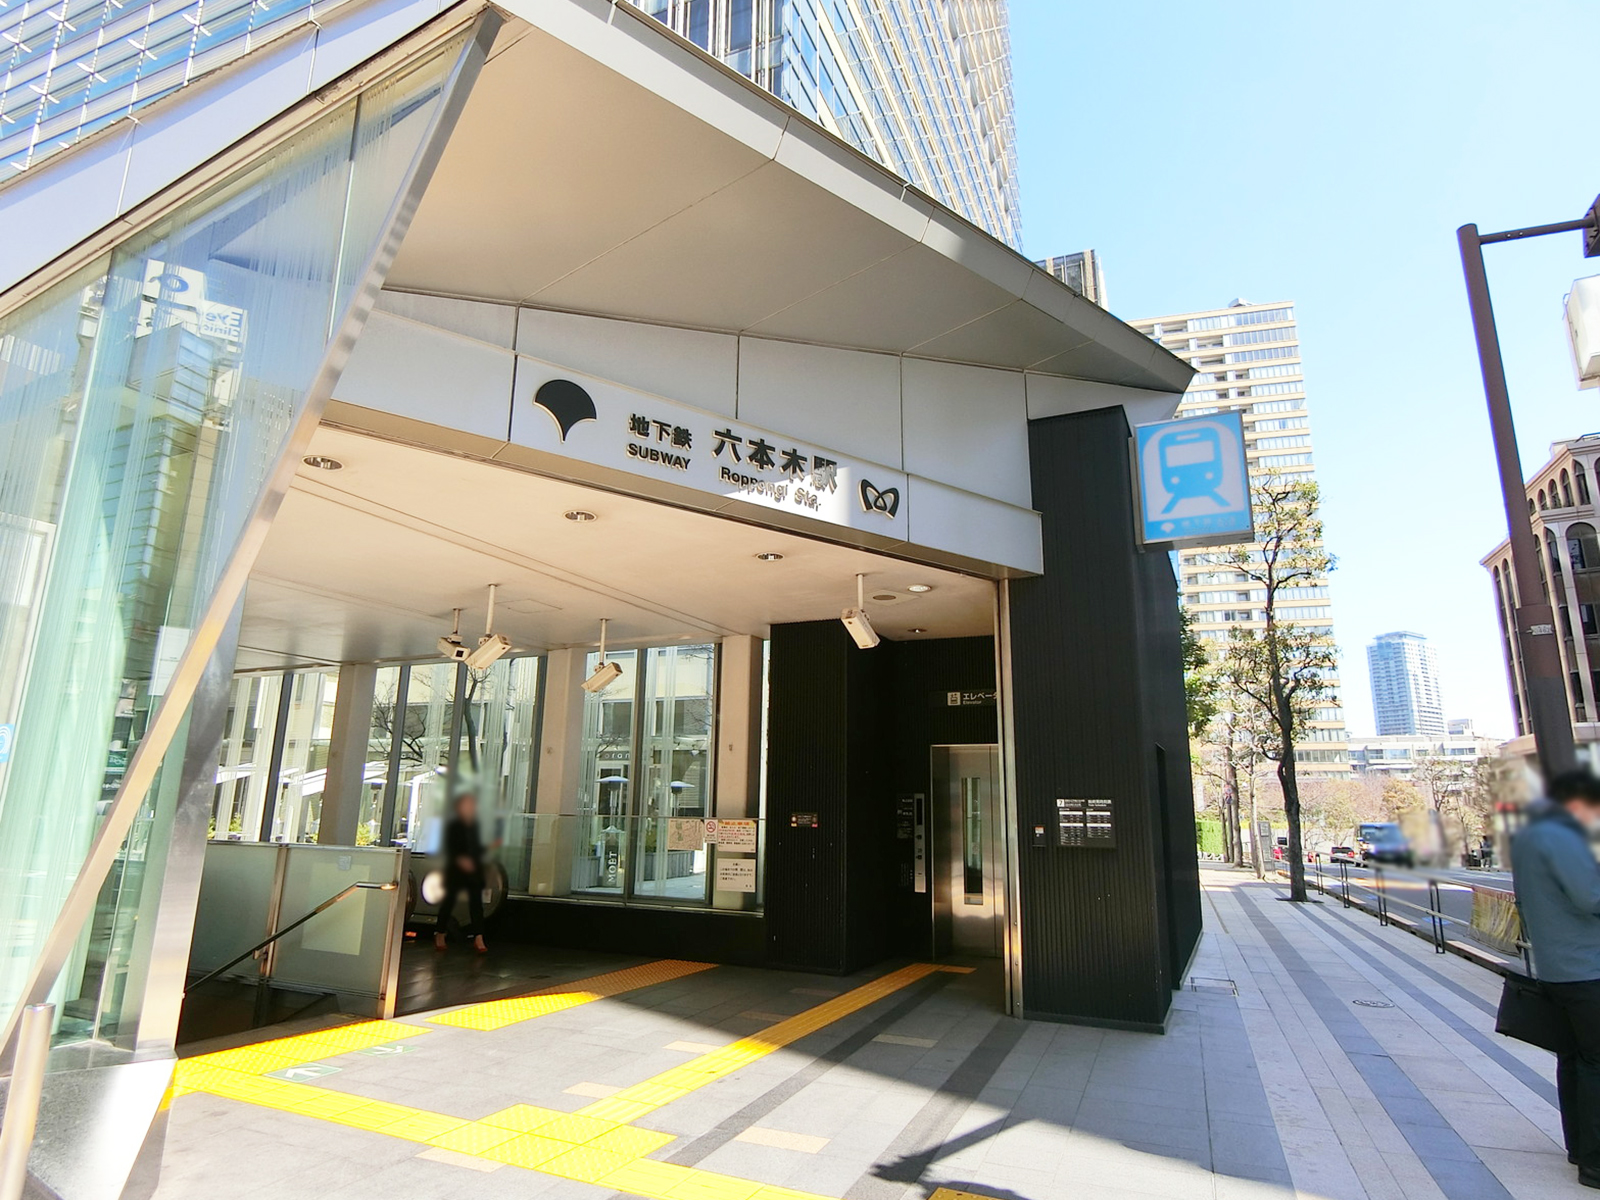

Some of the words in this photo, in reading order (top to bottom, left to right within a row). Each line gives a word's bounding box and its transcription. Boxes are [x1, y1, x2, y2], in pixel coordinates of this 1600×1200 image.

[627, 443, 691, 470] SUBWAY
[628, 413, 692, 450] 地下鉄
[712, 428, 837, 493] 六本木駅
[720, 466, 788, 501] Roppongi
